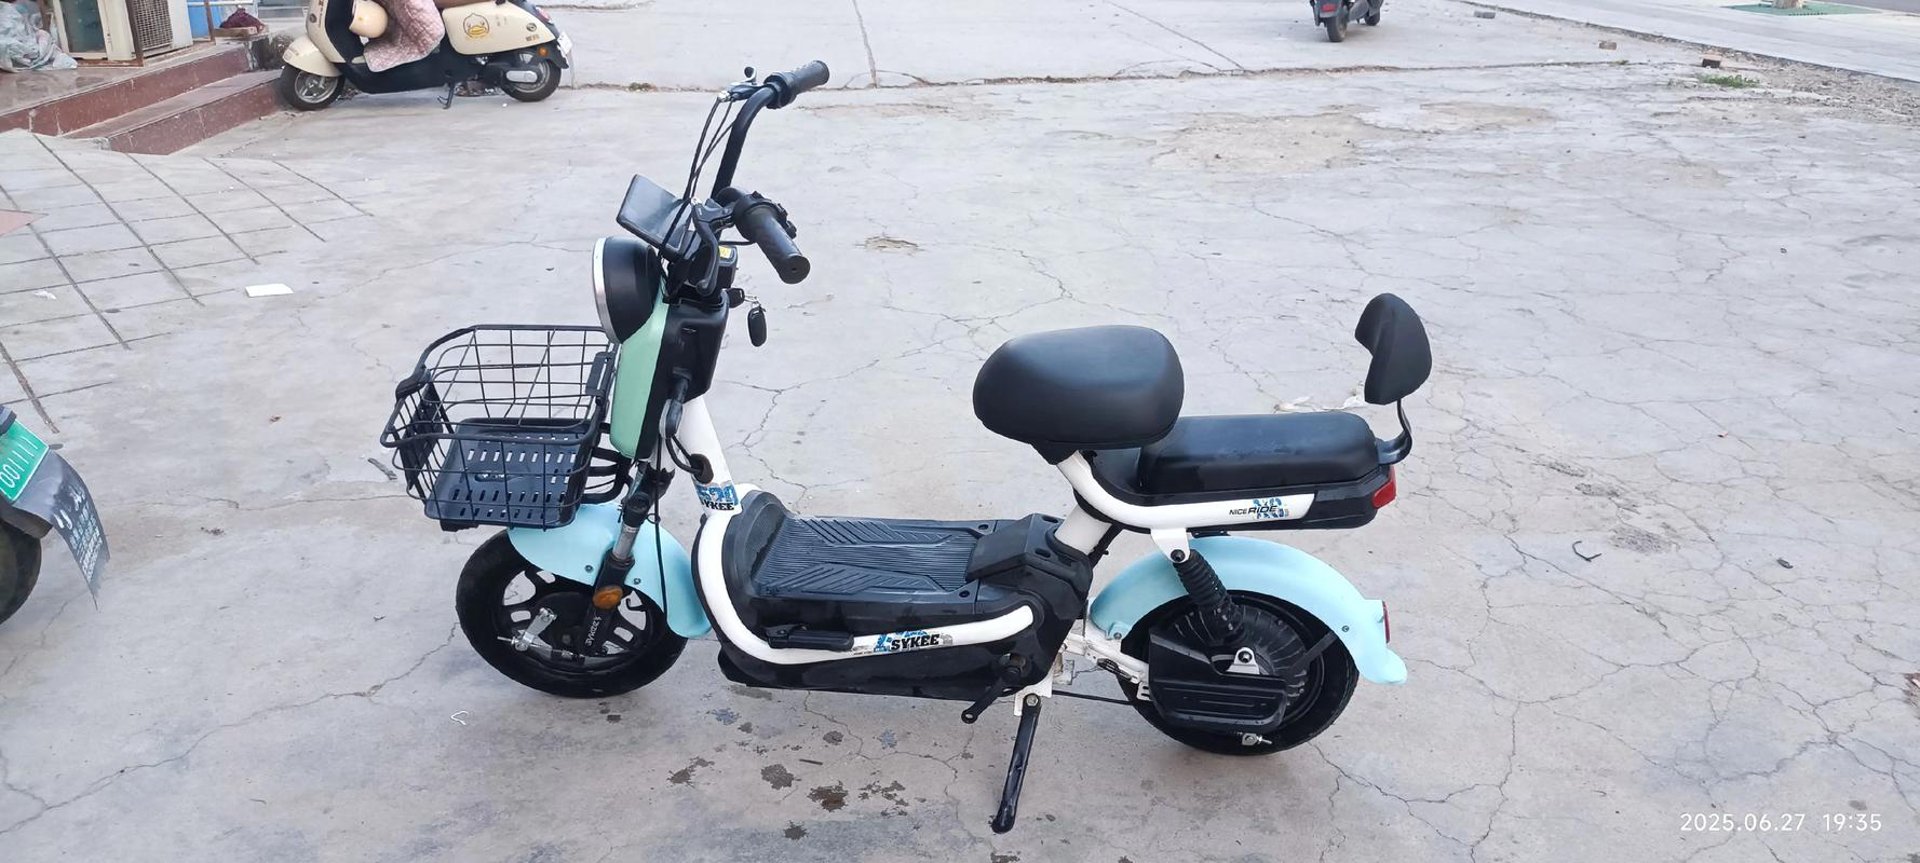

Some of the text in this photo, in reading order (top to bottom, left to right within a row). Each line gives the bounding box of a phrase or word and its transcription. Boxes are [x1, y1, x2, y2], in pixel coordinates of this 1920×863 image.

[1229, 507, 1247, 516] NICE
[1248, 505, 1277, 514] RIDE
[891, 634, 940, 651] SYKEE
